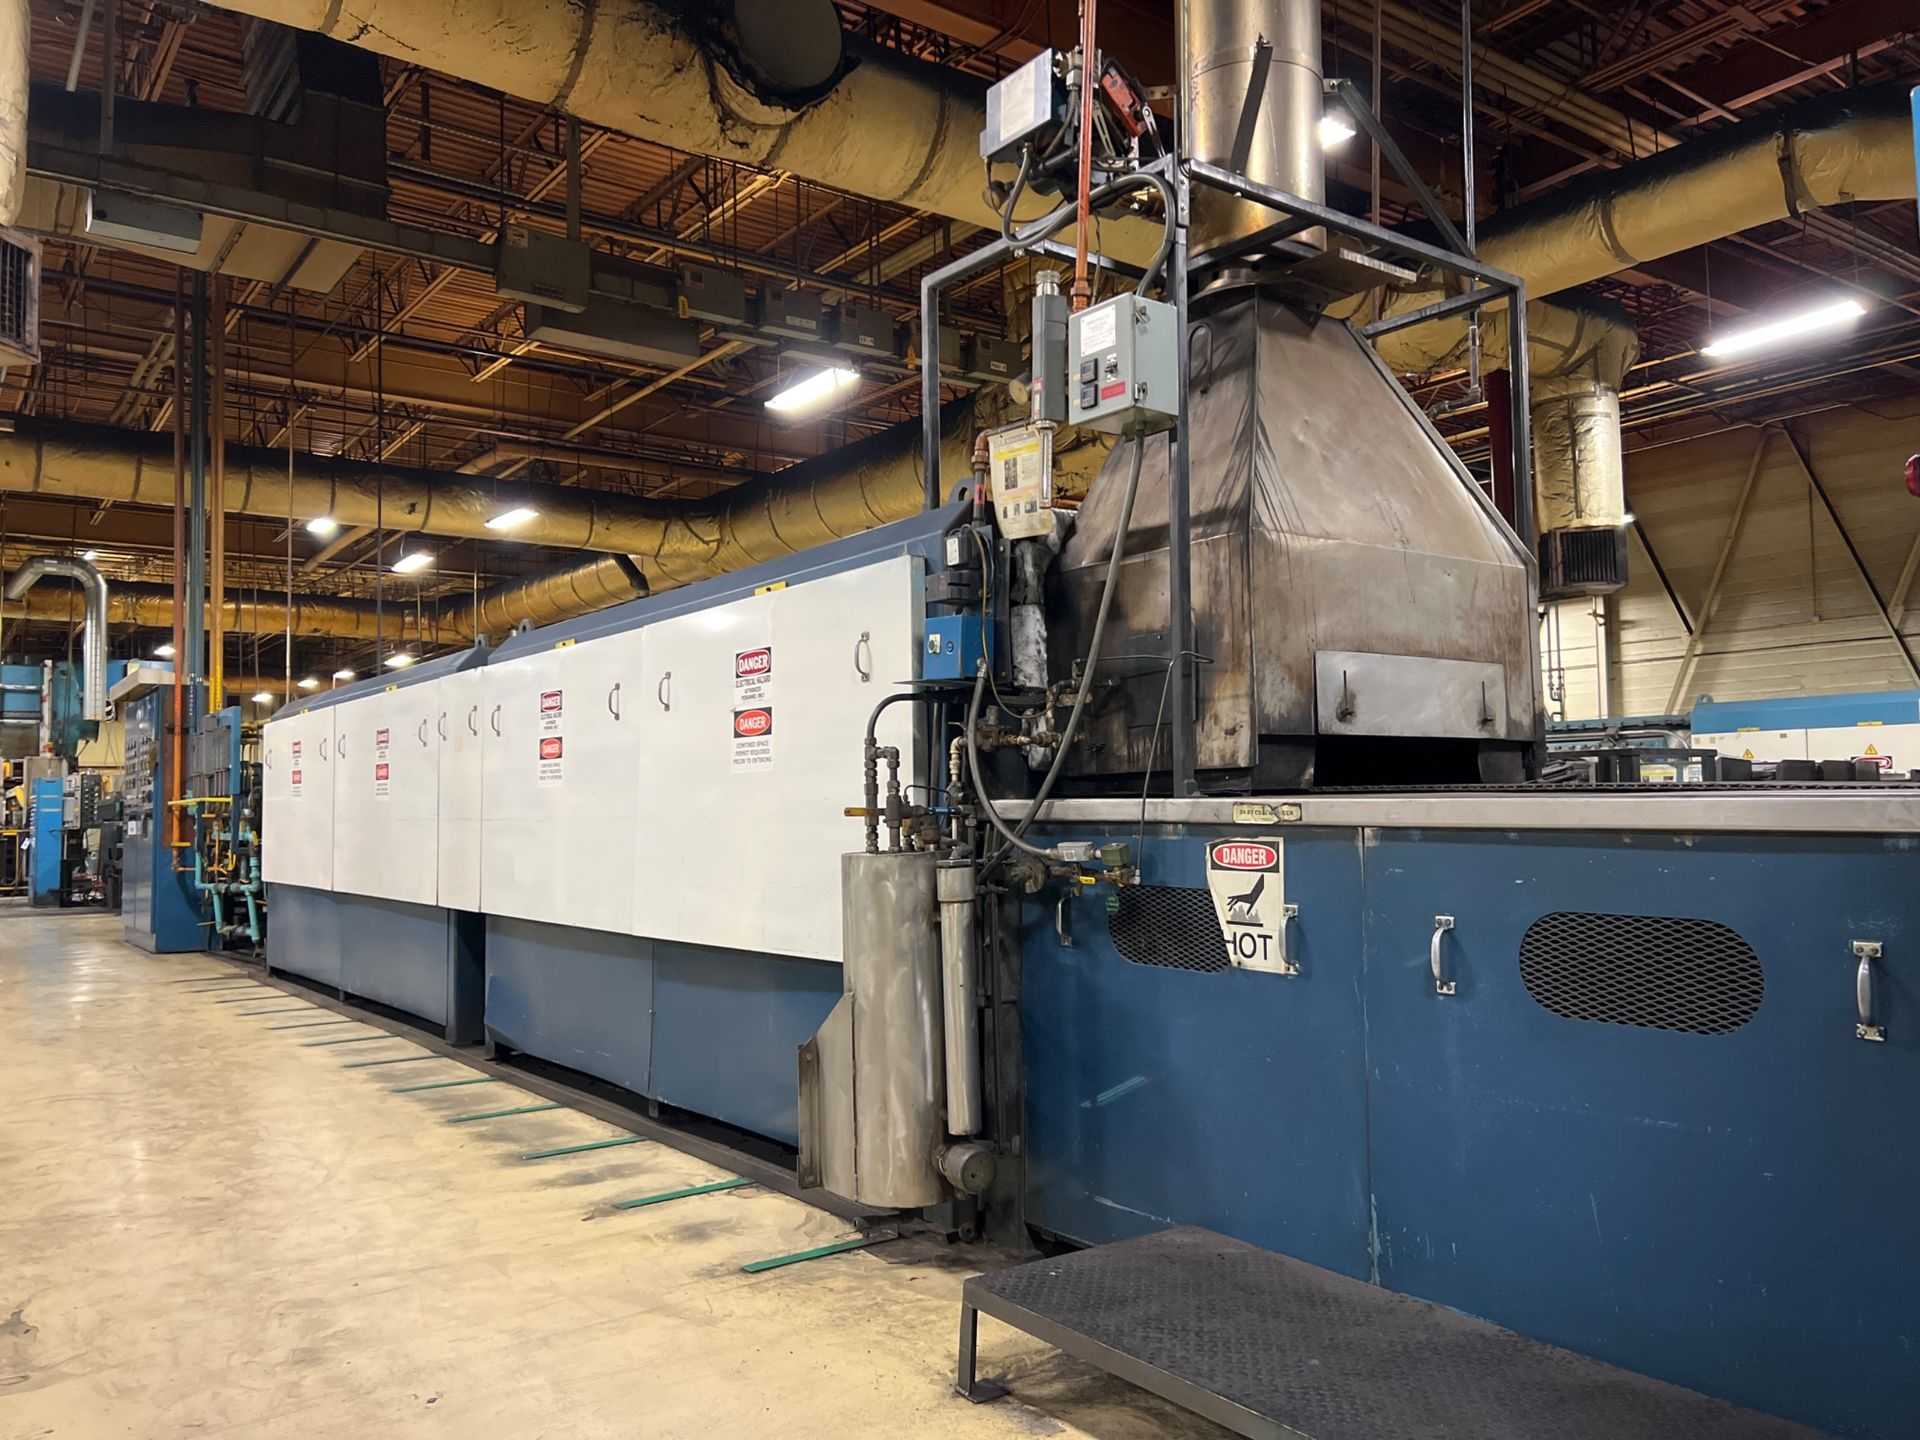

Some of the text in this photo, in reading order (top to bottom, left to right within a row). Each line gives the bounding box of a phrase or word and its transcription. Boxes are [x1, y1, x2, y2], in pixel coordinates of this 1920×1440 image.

[739, 654, 767, 672] DANGER
[739, 716, 765, 731] DANGER
[1223, 847, 1267, 865] DANGER
